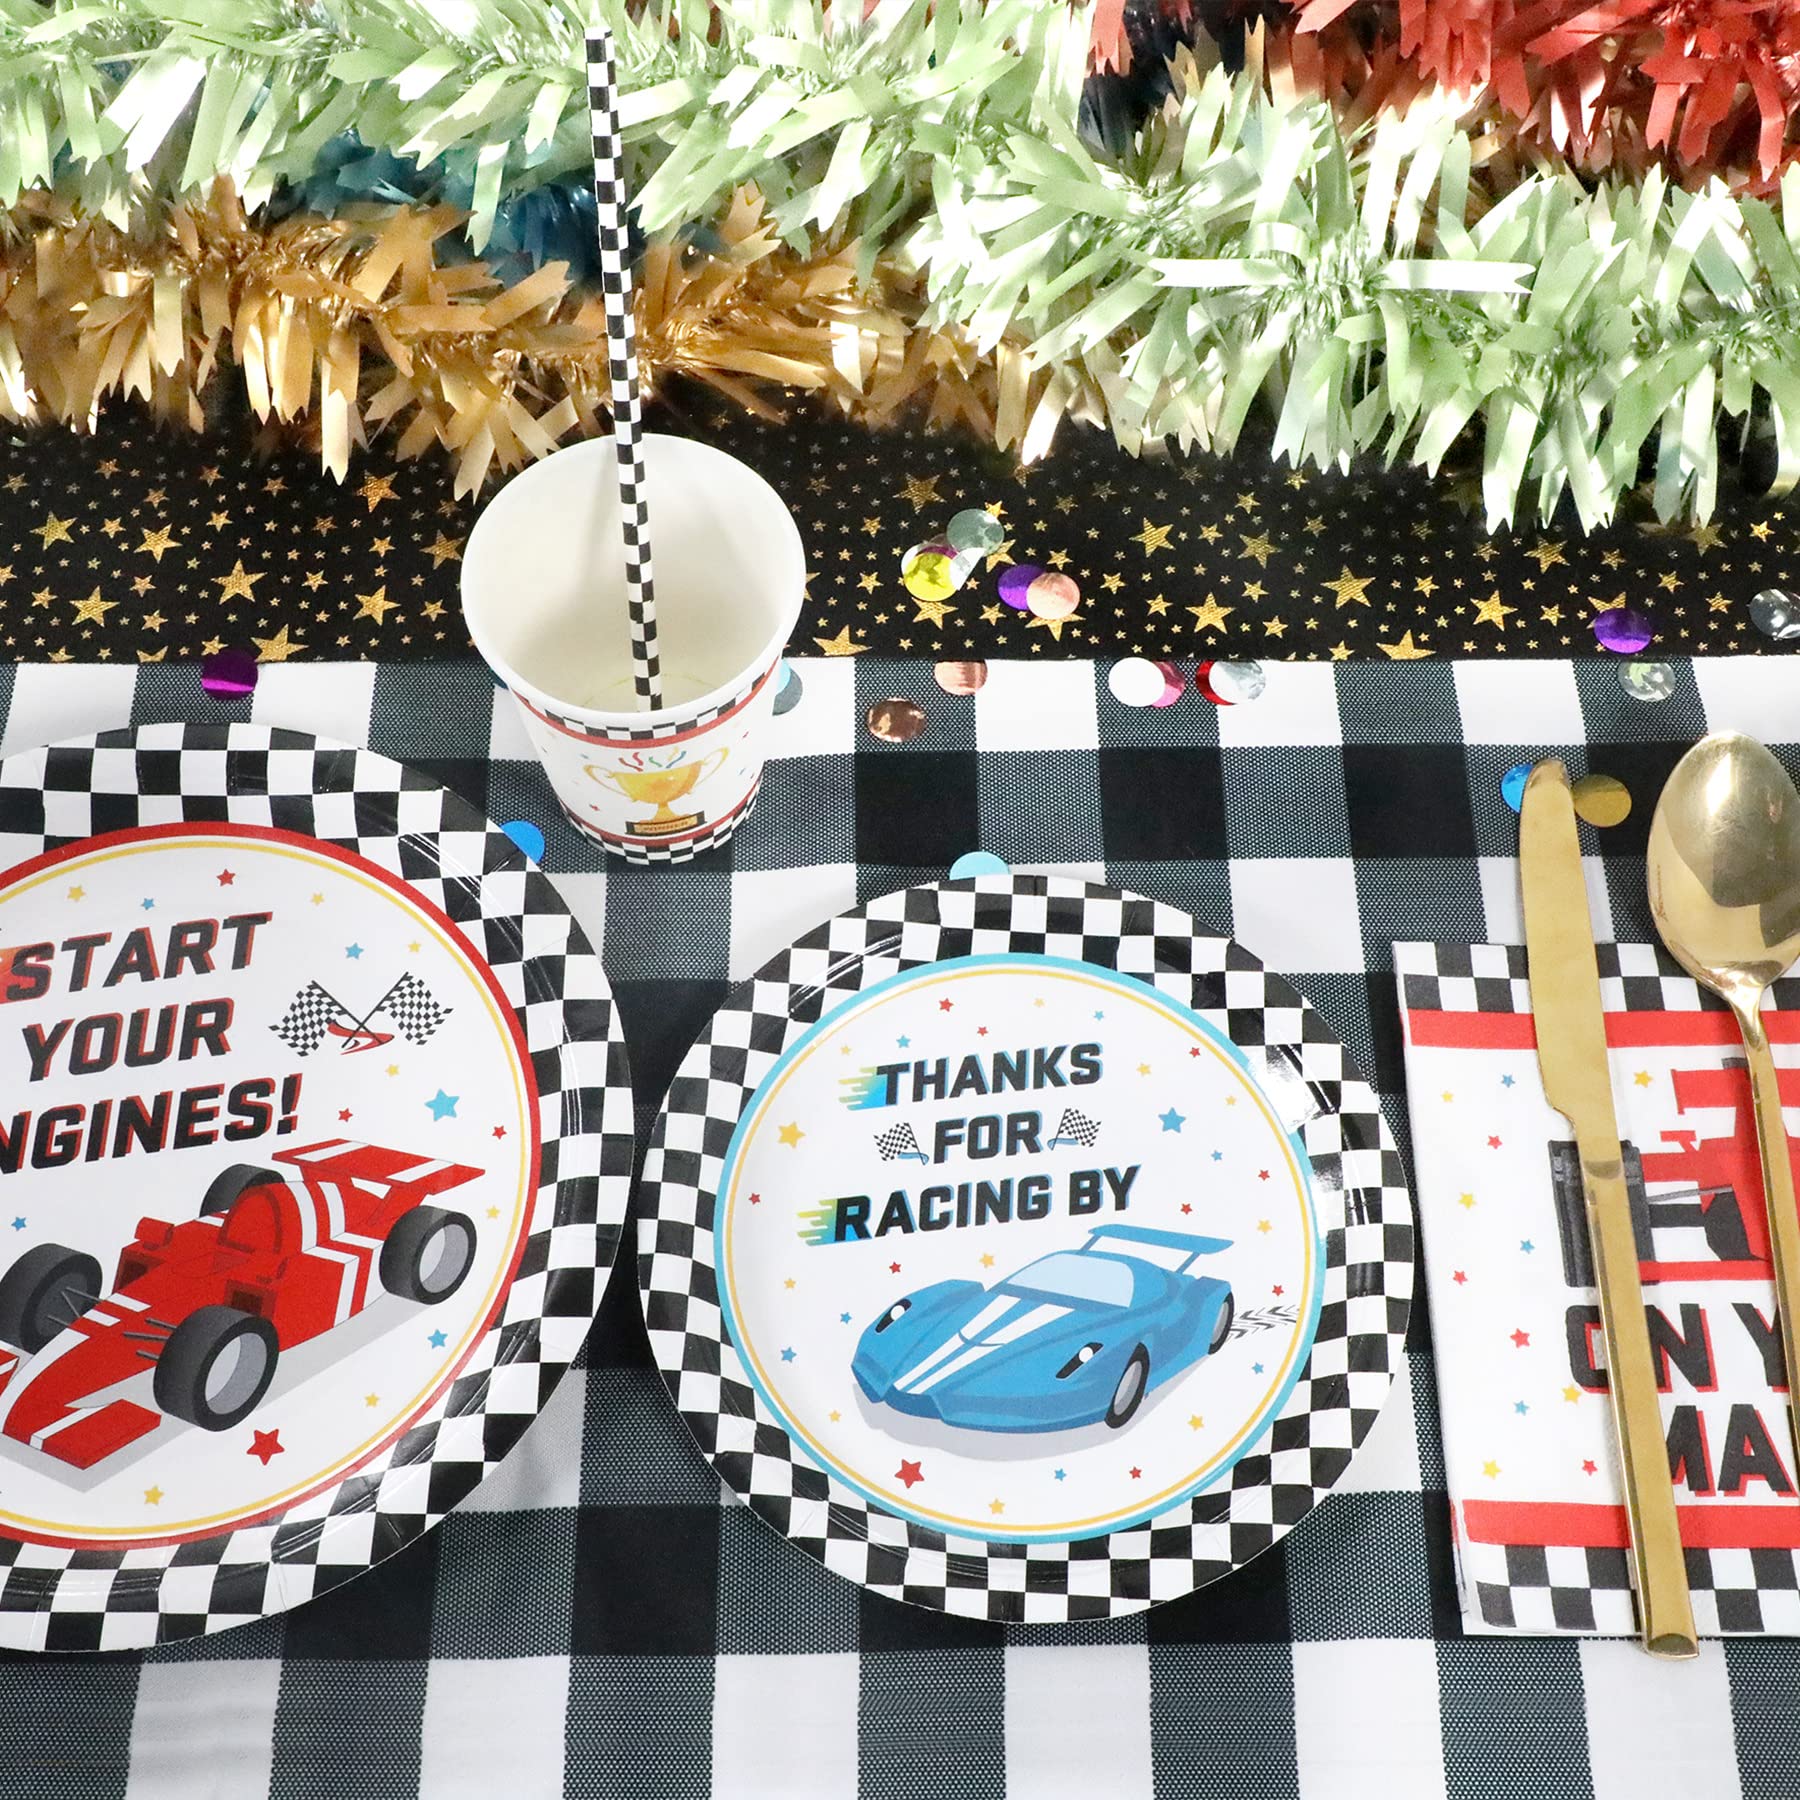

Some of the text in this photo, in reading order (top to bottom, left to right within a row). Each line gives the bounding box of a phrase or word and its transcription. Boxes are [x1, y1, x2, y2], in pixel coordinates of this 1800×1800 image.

[5, 911, 273, 1001] START
[21, 997, 235, 1083] YOUR
[875, 1042, 1103, 1107] THANKS
[933, 1109, 1043, 1165] FOR
[834, 1163, 1142, 1243] RACING BY
